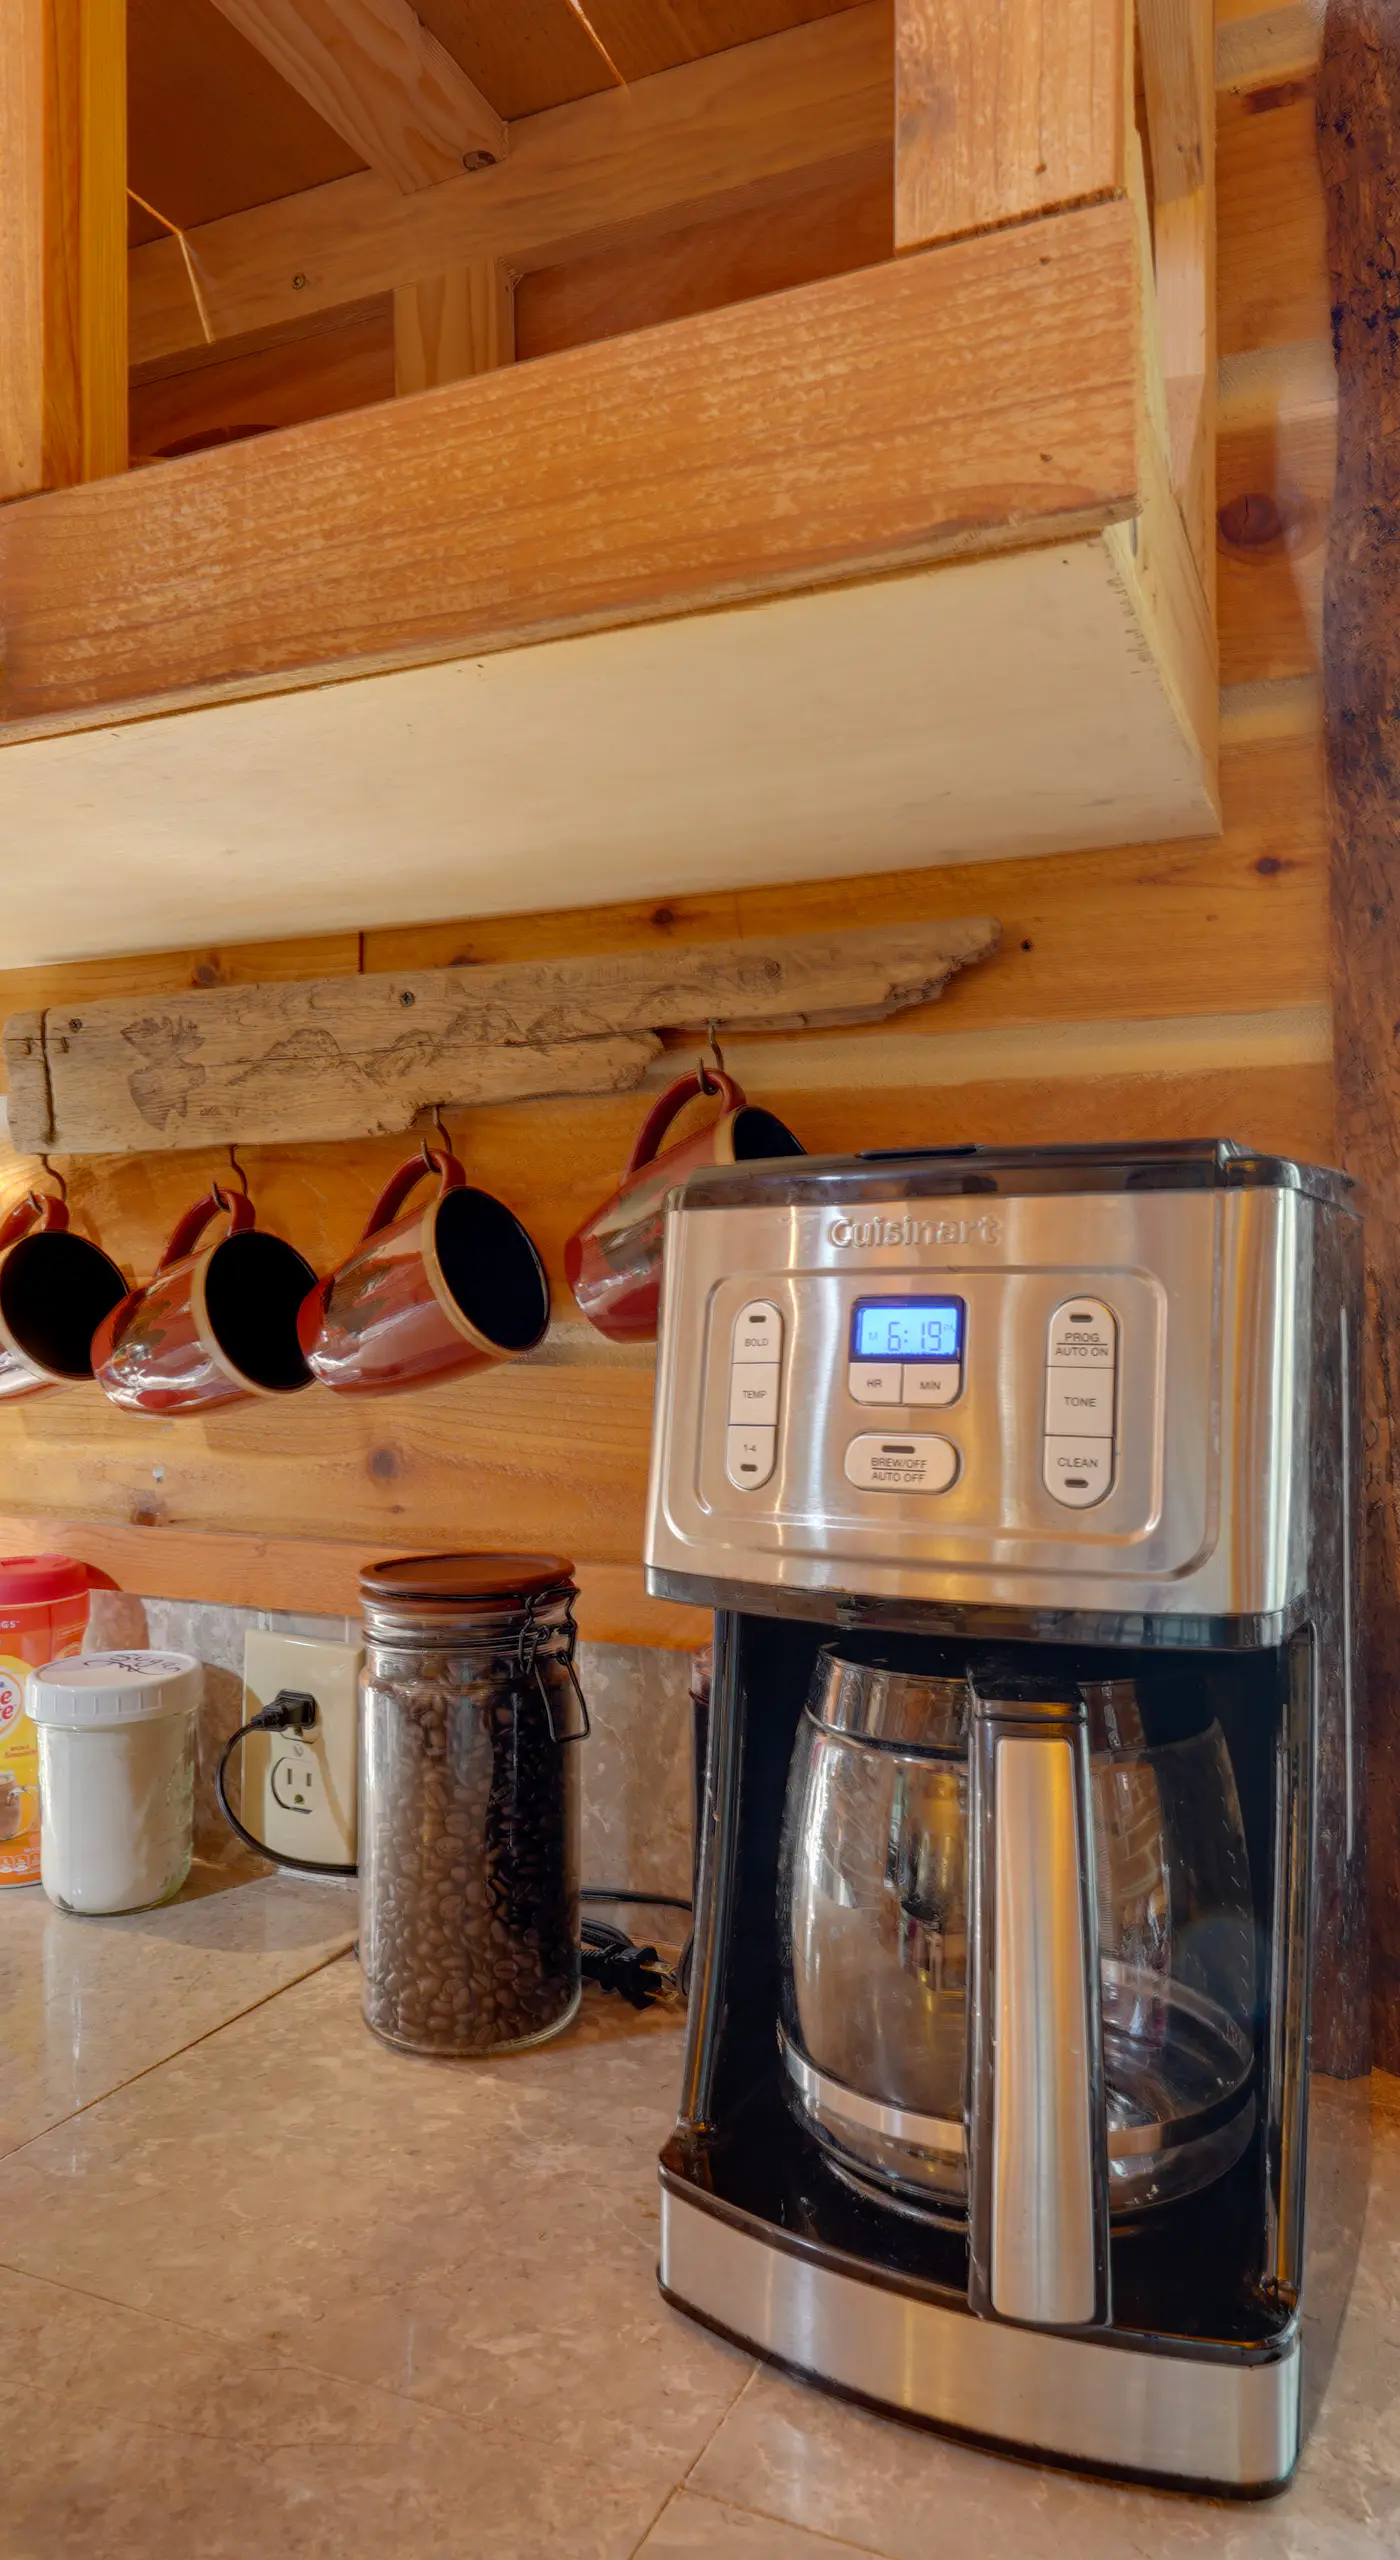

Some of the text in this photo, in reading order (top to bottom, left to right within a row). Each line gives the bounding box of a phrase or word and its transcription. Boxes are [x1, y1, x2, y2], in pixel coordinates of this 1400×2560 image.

[830, 1215, 1001, 1249] Cuisinart
[887, 1321, 942, 1352] 6:19
[1064, 1332, 1100, 1343] PROG
[744, 1338, 769, 1347] BOLD
[1055, 1347, 1109, 1357] AUTO ON
[866, 1379, 883, 1388] HR
[920, 1381, 941, 1390] MIN
[742, 1390, 768, 1399] TEMP
[1064, 1396, 1097, 1408] TONE
[743, 1444, 757, 1453] 1-4
[871, 1457, 928, 1469] BREW/OFF
[1057, 1457, 1099, 1469] CLEAN
[872, 1471, 926, 1484] AUTO OFF
